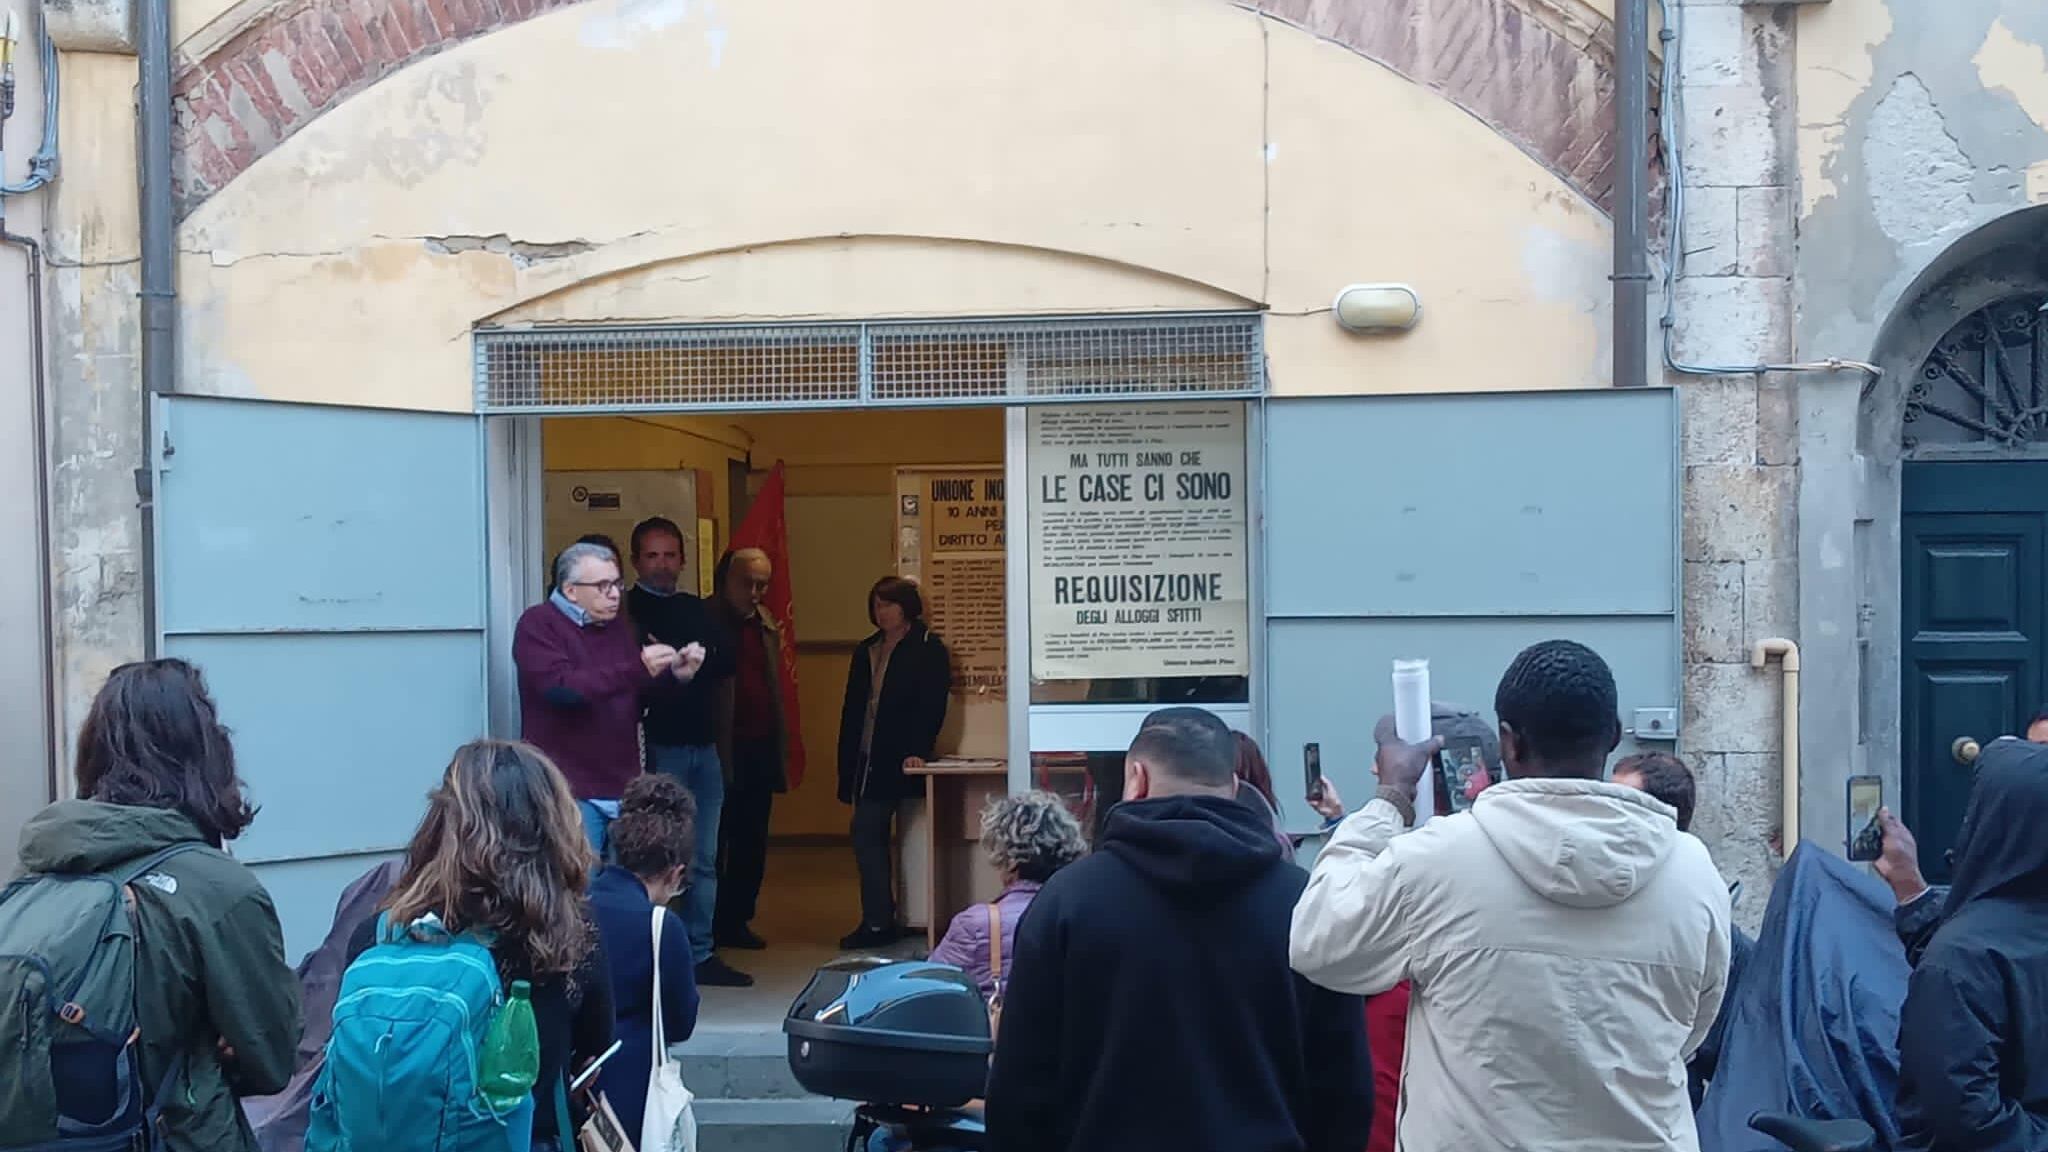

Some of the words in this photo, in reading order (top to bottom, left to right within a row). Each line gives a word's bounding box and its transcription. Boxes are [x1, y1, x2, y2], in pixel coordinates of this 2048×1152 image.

[1070, 453, 1088, 468] MA
[1096, 452, 1128, 468] TUTTI
[1136, 451, 1173, 467] SANNO
[1180, 450, 1202, 466] CHE
[931, 479, 975, 502] UNIONE
[1042, 474, 1067, 503] LE
[1079, 473, 1133, 502] CASE
[1144, 472, 1164, 502] CI
[1176, 471, 1231, 501] SONO
[947, 506, 960, 518] 10
[939, 533, 988, 546] DIRITTO
[1055, 572, 1223, 605] REQUISIZIONE
[1076, 609, 1108, 625] DEGLI
[1115, 608, 1160, 624] ALLOGGI
[1167, 606, 1202, 623] SFITTI
